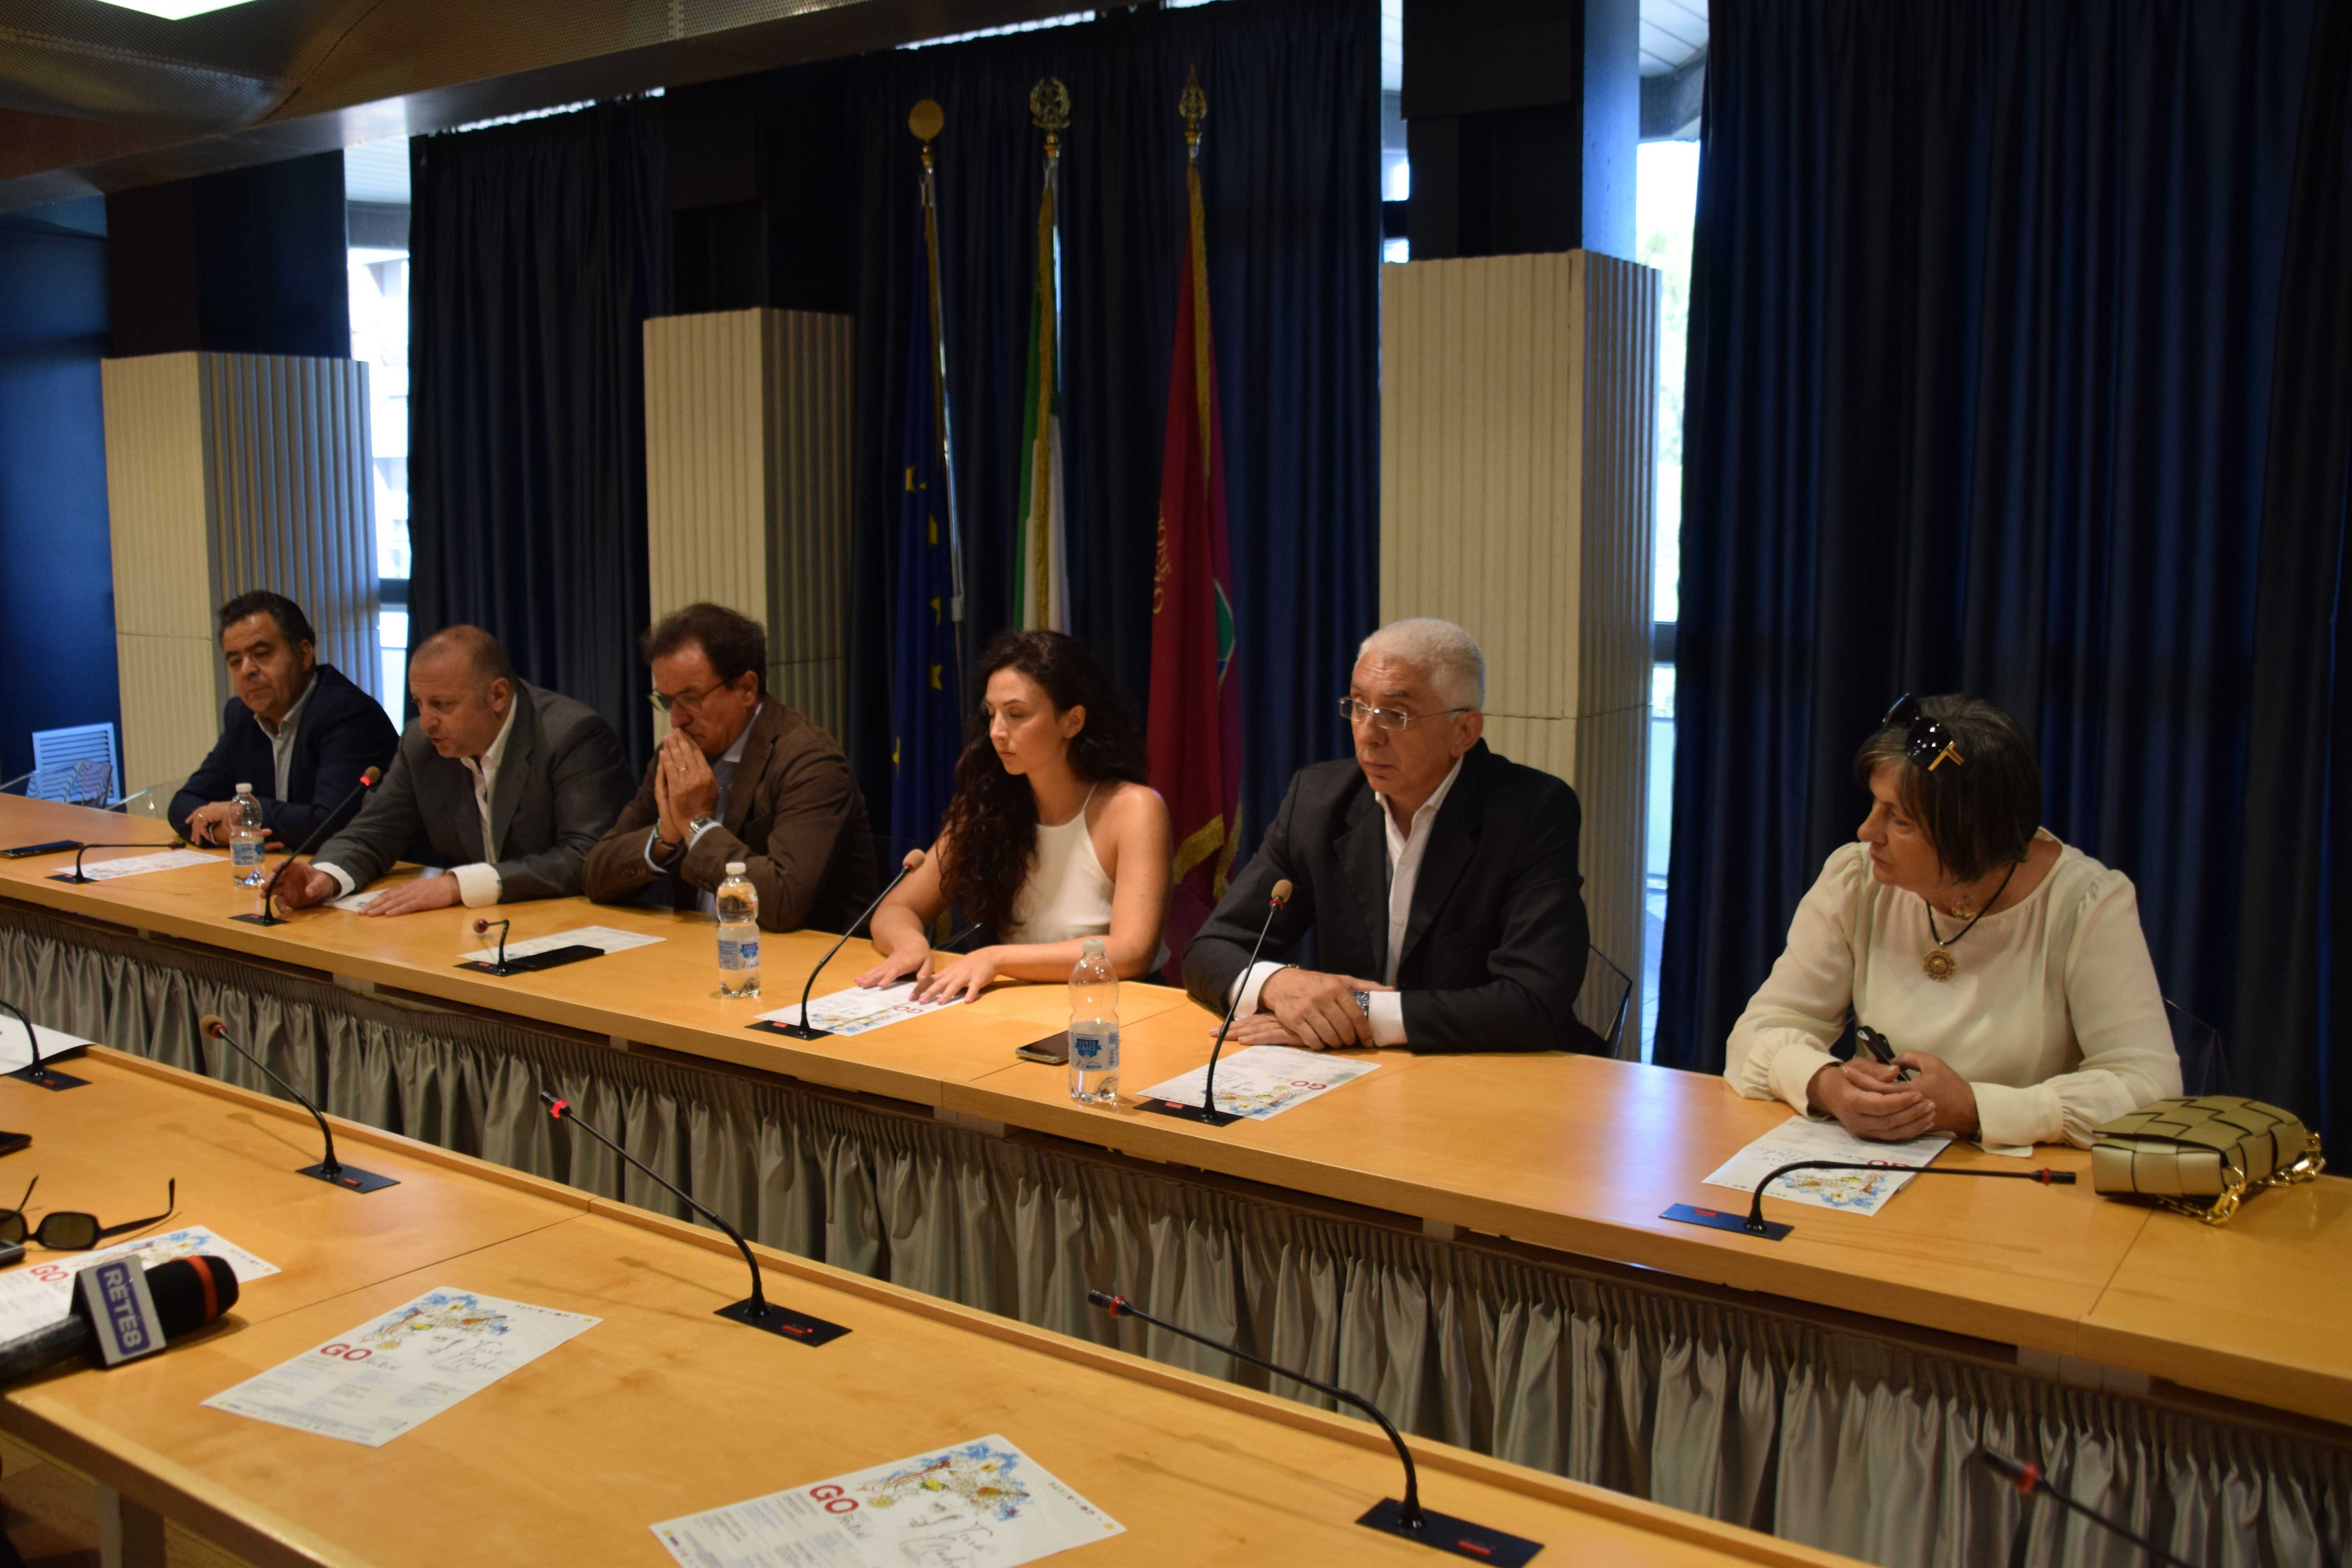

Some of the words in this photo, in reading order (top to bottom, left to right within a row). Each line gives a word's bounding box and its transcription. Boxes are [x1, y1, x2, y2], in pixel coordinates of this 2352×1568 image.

[1290, 1080, 1327, 1090] GO
[30, 1265, 69, 1281] GO
[104, 1269, 142, 1348] RETE8
[320, 1343, 372, 1361] GO
[809, 1485, 859, 1514] GO
